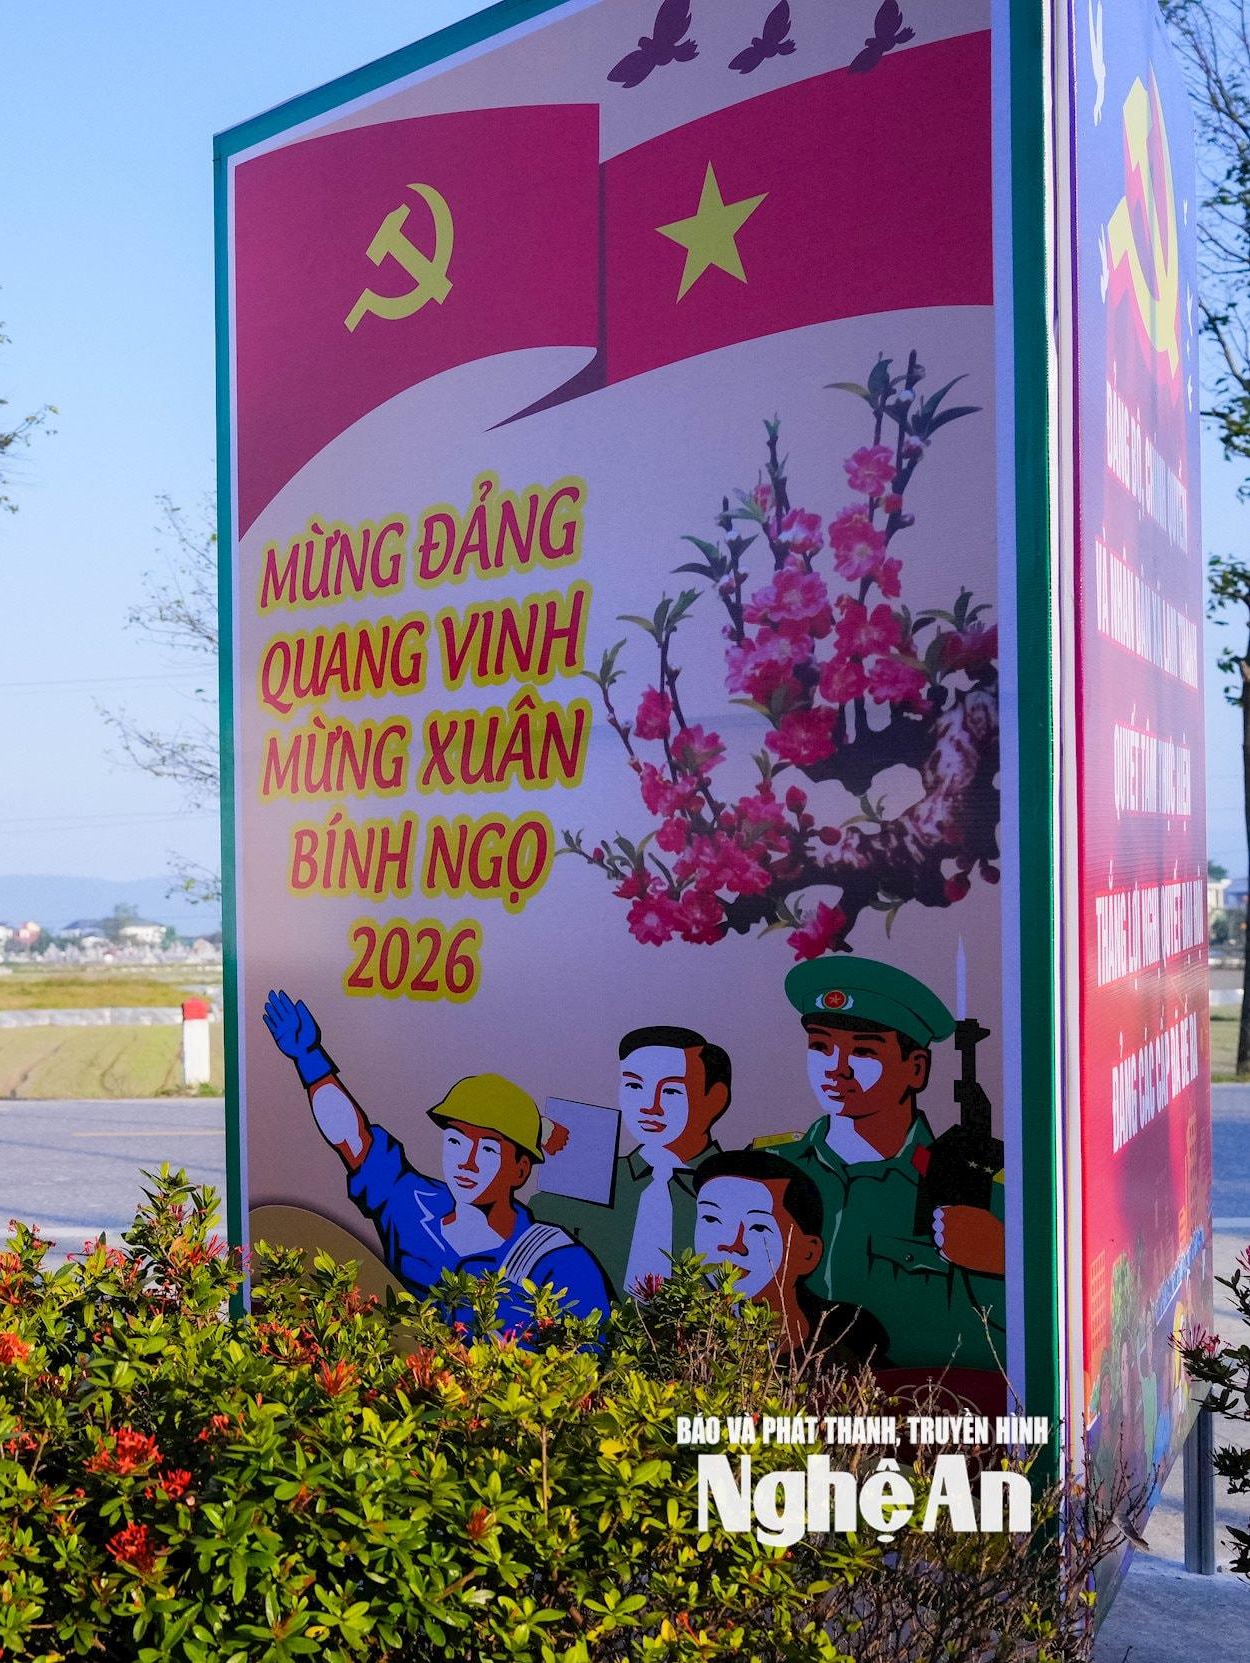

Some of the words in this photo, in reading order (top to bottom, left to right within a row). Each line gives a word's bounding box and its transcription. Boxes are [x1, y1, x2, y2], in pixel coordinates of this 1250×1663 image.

[260, 522, 405, 608] MỪNG
[419, 480, 581, 581] ĐẢNG
[261, 620, 425, 714] QUANG
[441, 589, 585, 682] VINH
[262, 716, 406, 796] MỪNG
[422, 693, 585, 786] XUÂN
[1114, 703, 1141, 820] QUYẾT
[290, 812, 413, 894] BÍNH
[426, 821, 547, 904] NGỌ
[347, 925, 478, 994] 2026
[1095, 859, 1127, 988] THẮNG
